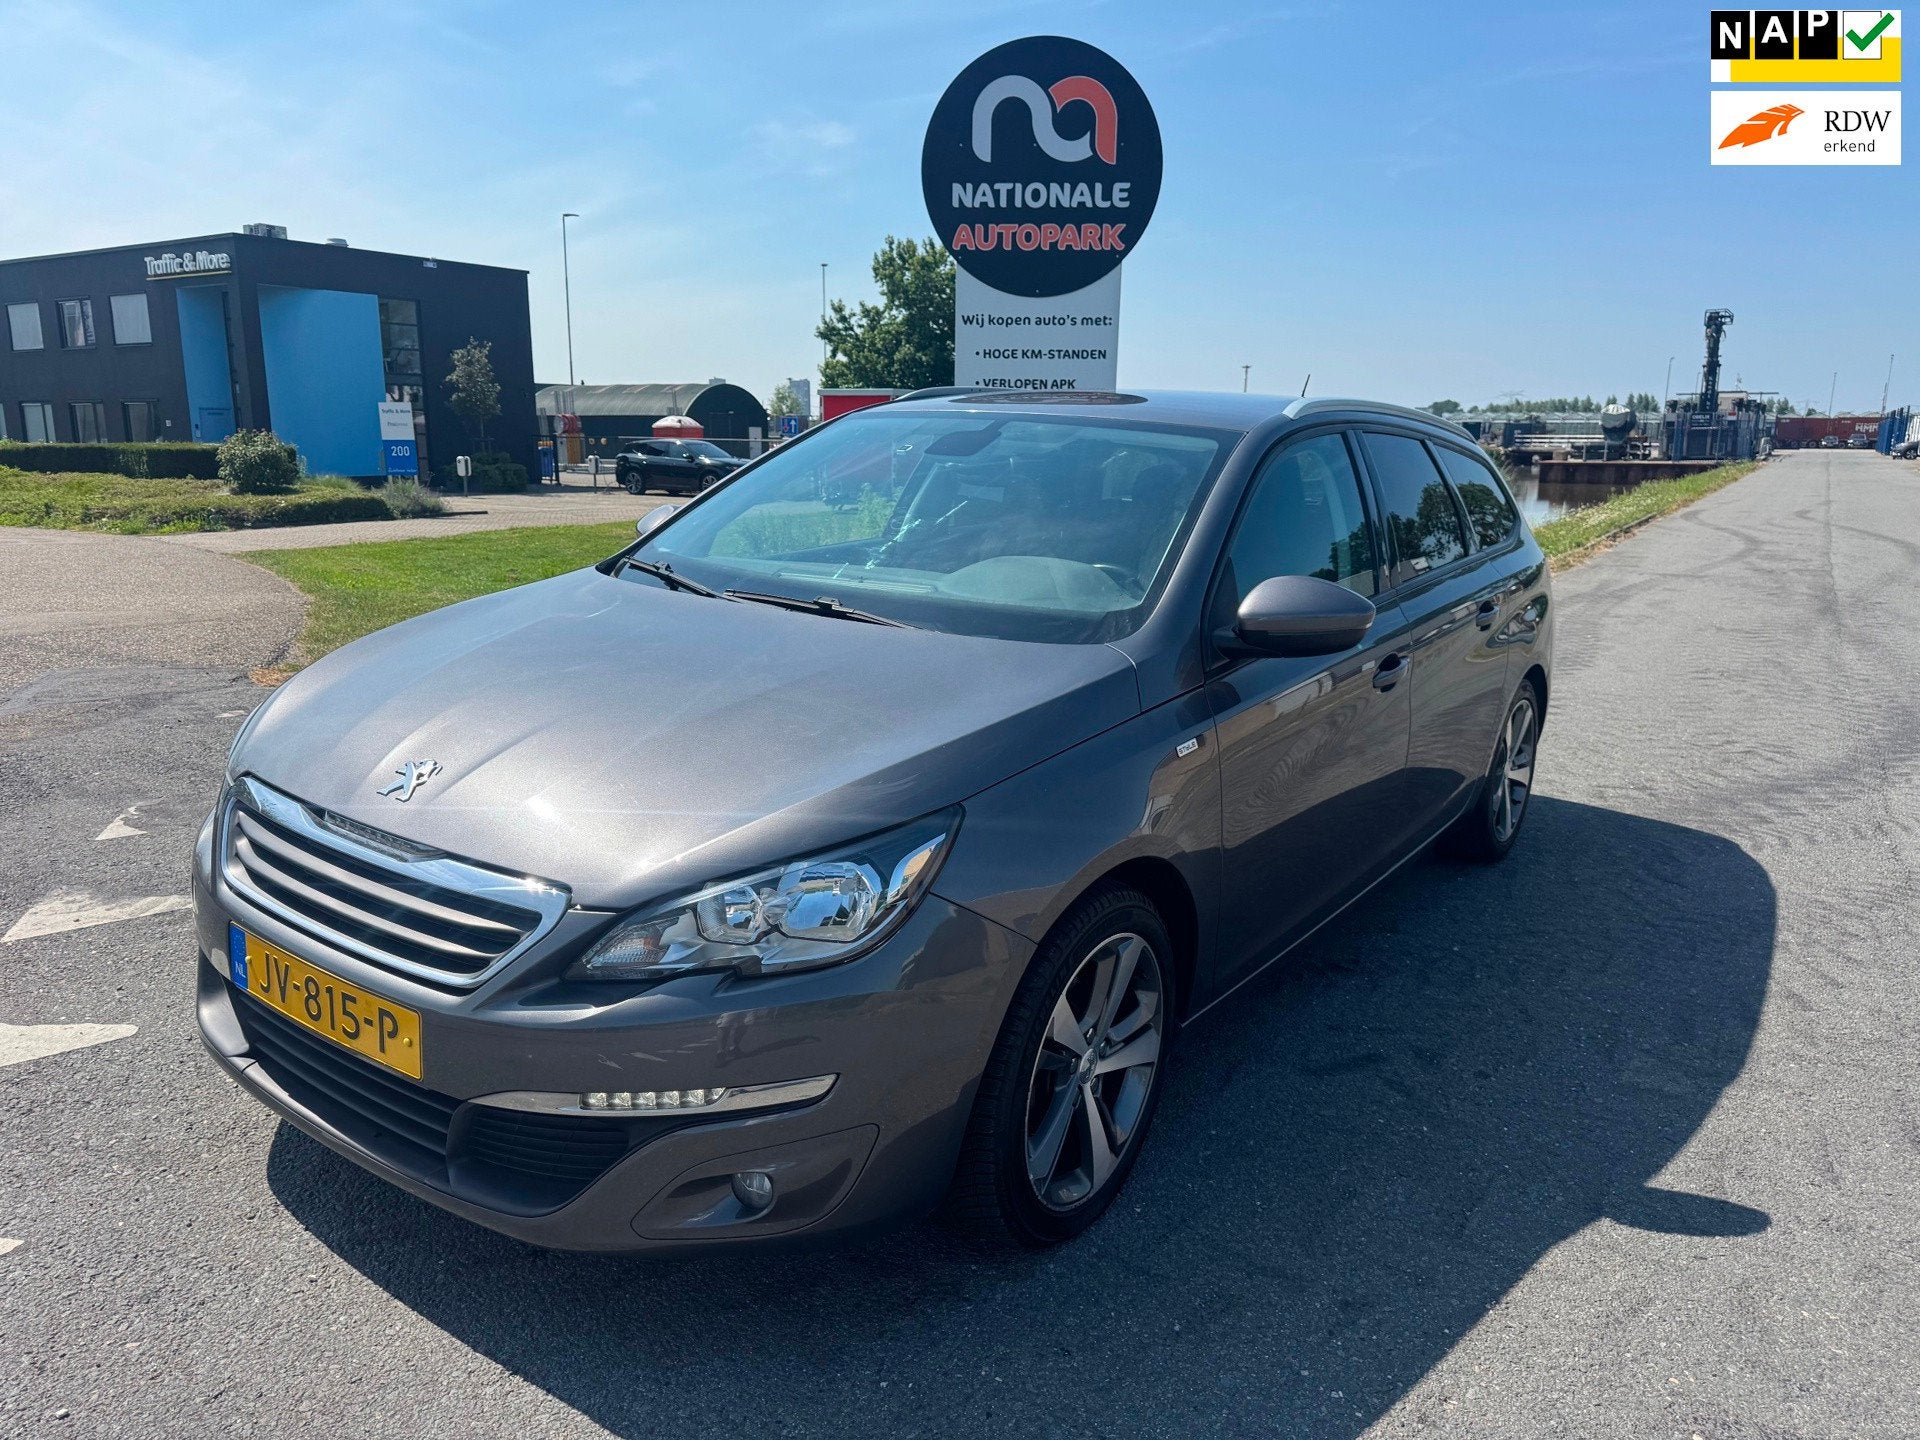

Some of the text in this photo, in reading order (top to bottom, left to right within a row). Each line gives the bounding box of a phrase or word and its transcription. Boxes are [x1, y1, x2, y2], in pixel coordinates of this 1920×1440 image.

[952, 182, 1131, 208] NATIONALE
[952, 223, 1127, 251] AUTOPARK
[144, 250, 231, 275] Traffic & More
[961, 313, 985, 328] Wij
[988, 314, 1031, 327] kopen
[1081, 315, 1113, 326] met:
[983, 349, 1107, 360] HOGE KM-STANDEN
[983, 378, 1076, 389] VERLOPEN APK
[391, 446, 410, 456] 200
[235, 961, 247, 978] NL
[259, 951, 399, 1054] JV-815-P
